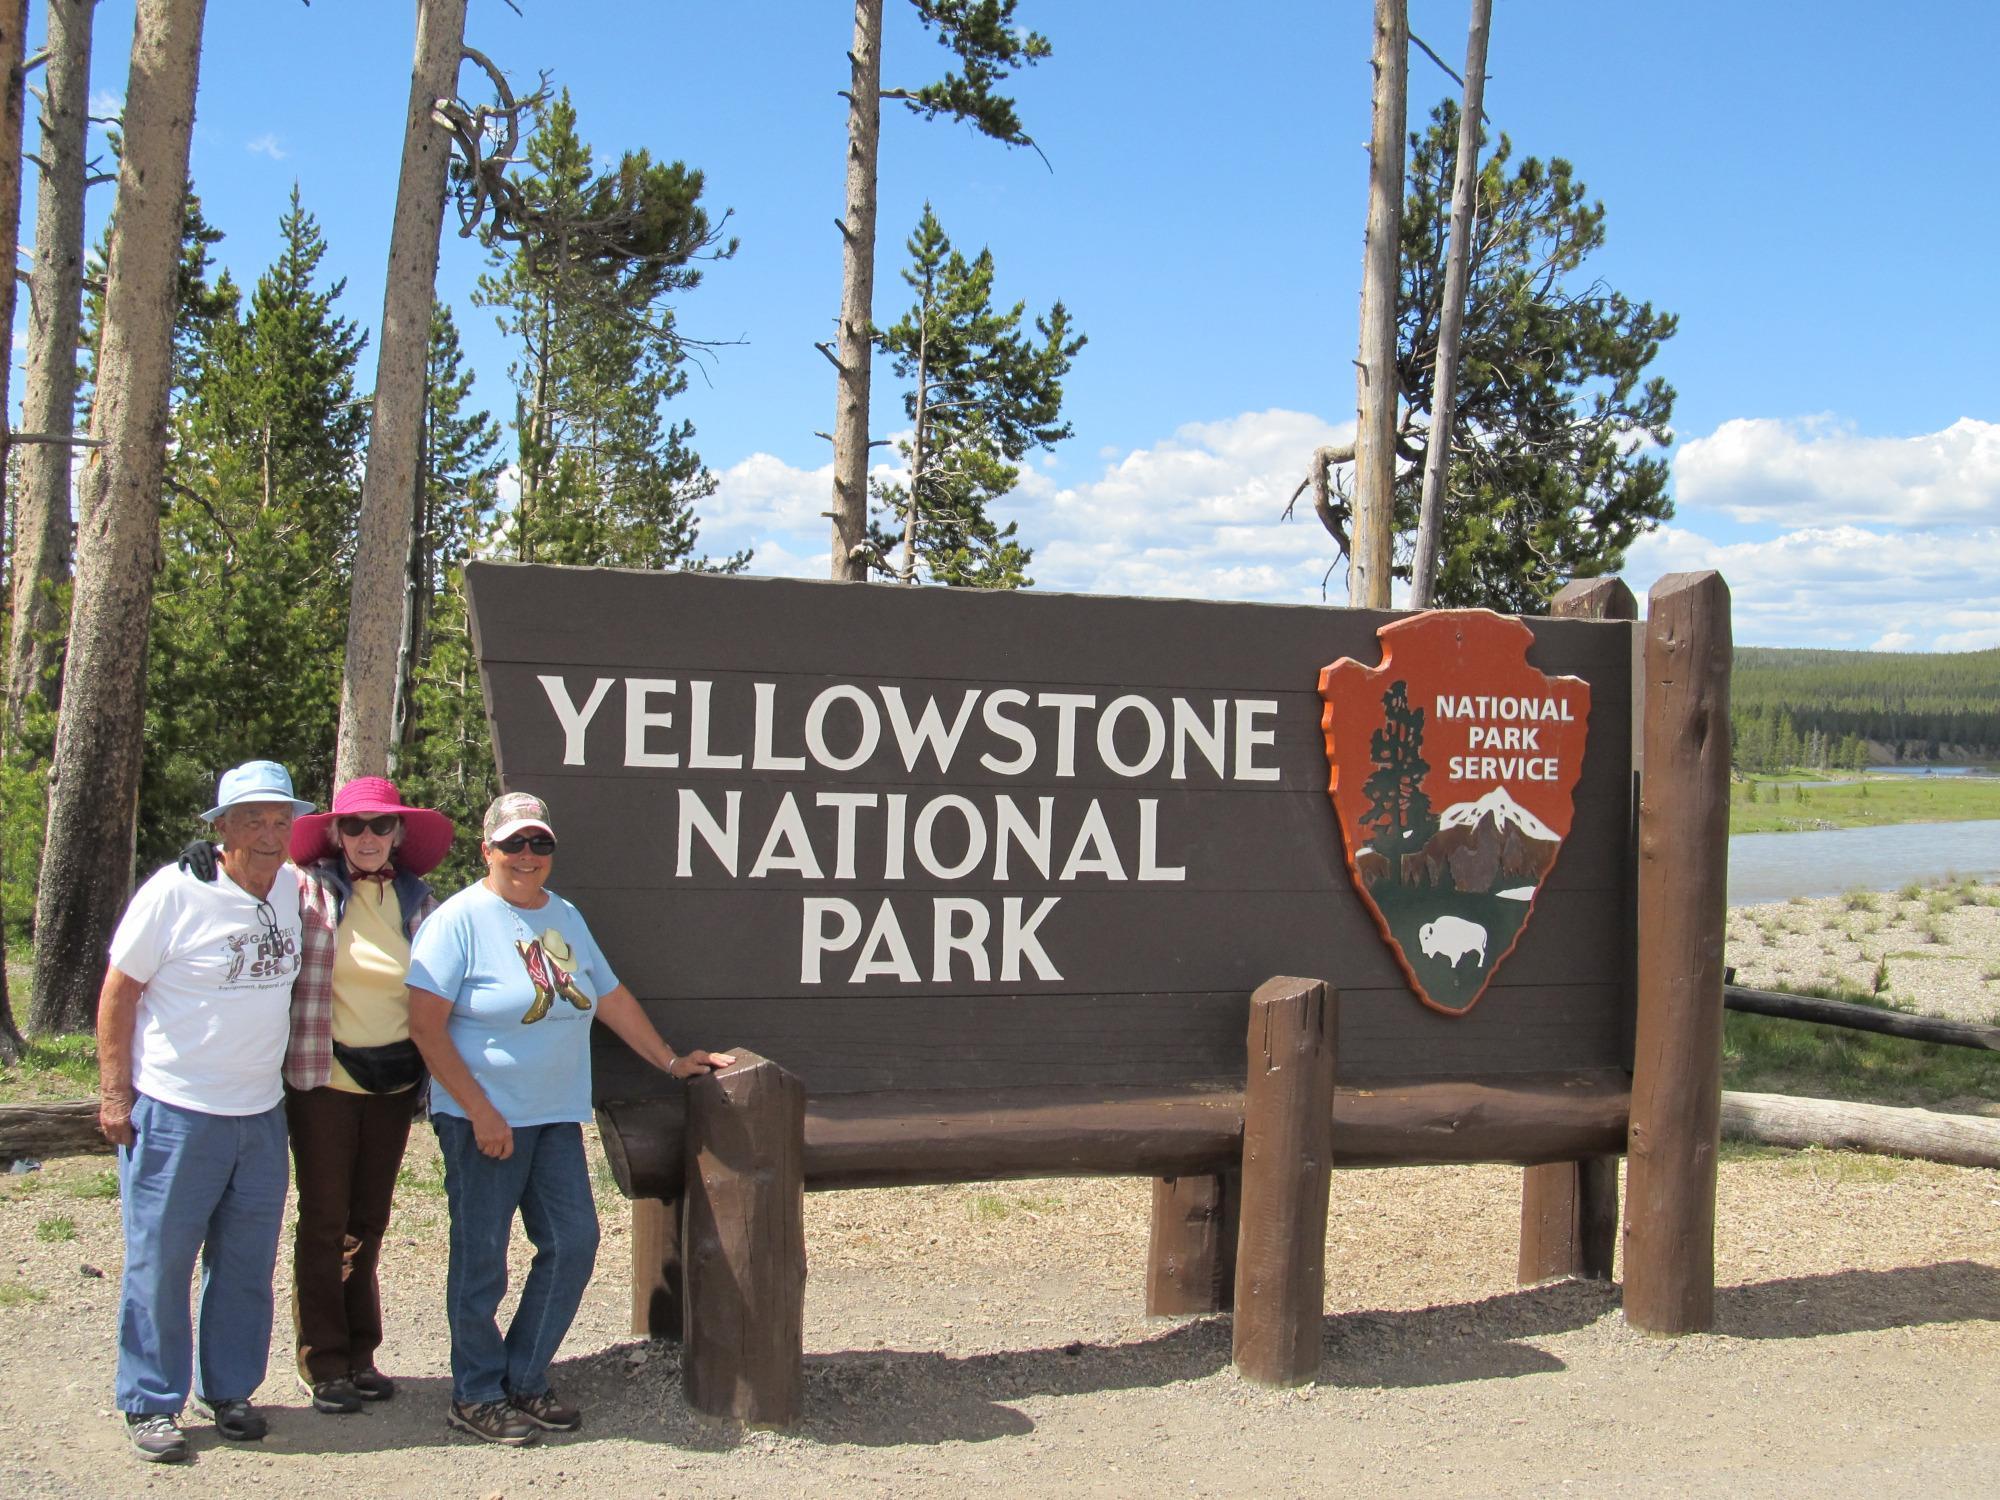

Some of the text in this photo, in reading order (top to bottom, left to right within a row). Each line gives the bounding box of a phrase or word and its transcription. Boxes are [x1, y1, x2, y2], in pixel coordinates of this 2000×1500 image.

[1437, 695, 1575, 721] NATIONAL
[537, 675, 1281, 781] YELLOWSTONE
[1469, 726, 1540, 750] PARK
[1449, 757, 1559, 781] SERVICE
[675, 788, 1186, 881] NATIONAL
[258, 938, 295, 960] PRO
[800, 896, 1065, 983] PARK
[250, 954, 301, 977] SHOP
